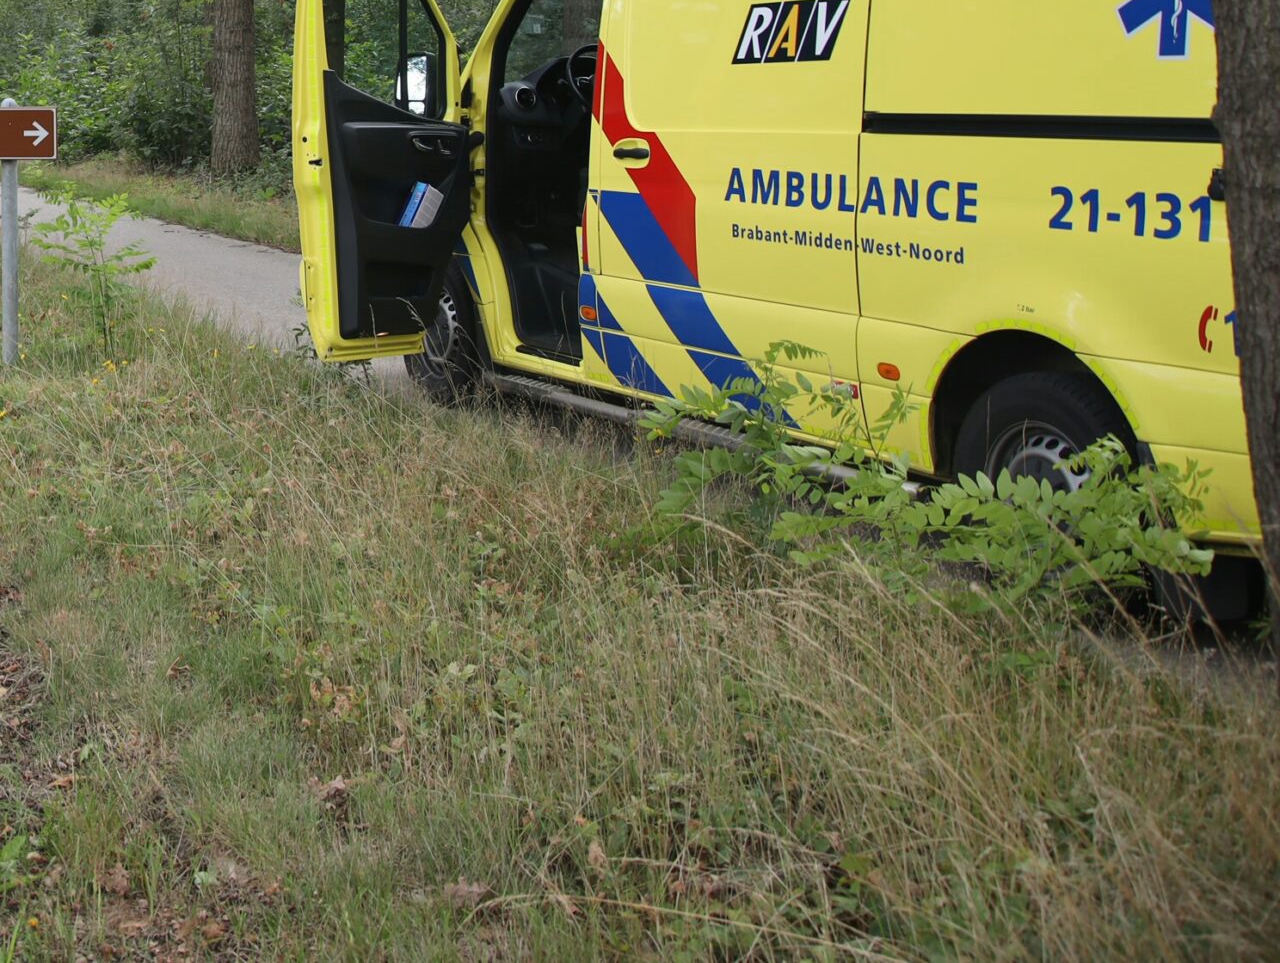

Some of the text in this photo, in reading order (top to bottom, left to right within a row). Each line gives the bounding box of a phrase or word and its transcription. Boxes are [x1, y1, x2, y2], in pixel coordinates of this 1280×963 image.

[723, 167, 979, 224] AMBULANCE
[1048, 185, 1212, 243] 21-131
[731, 222, 965, 265] Brabant-Midden-West-Noord
